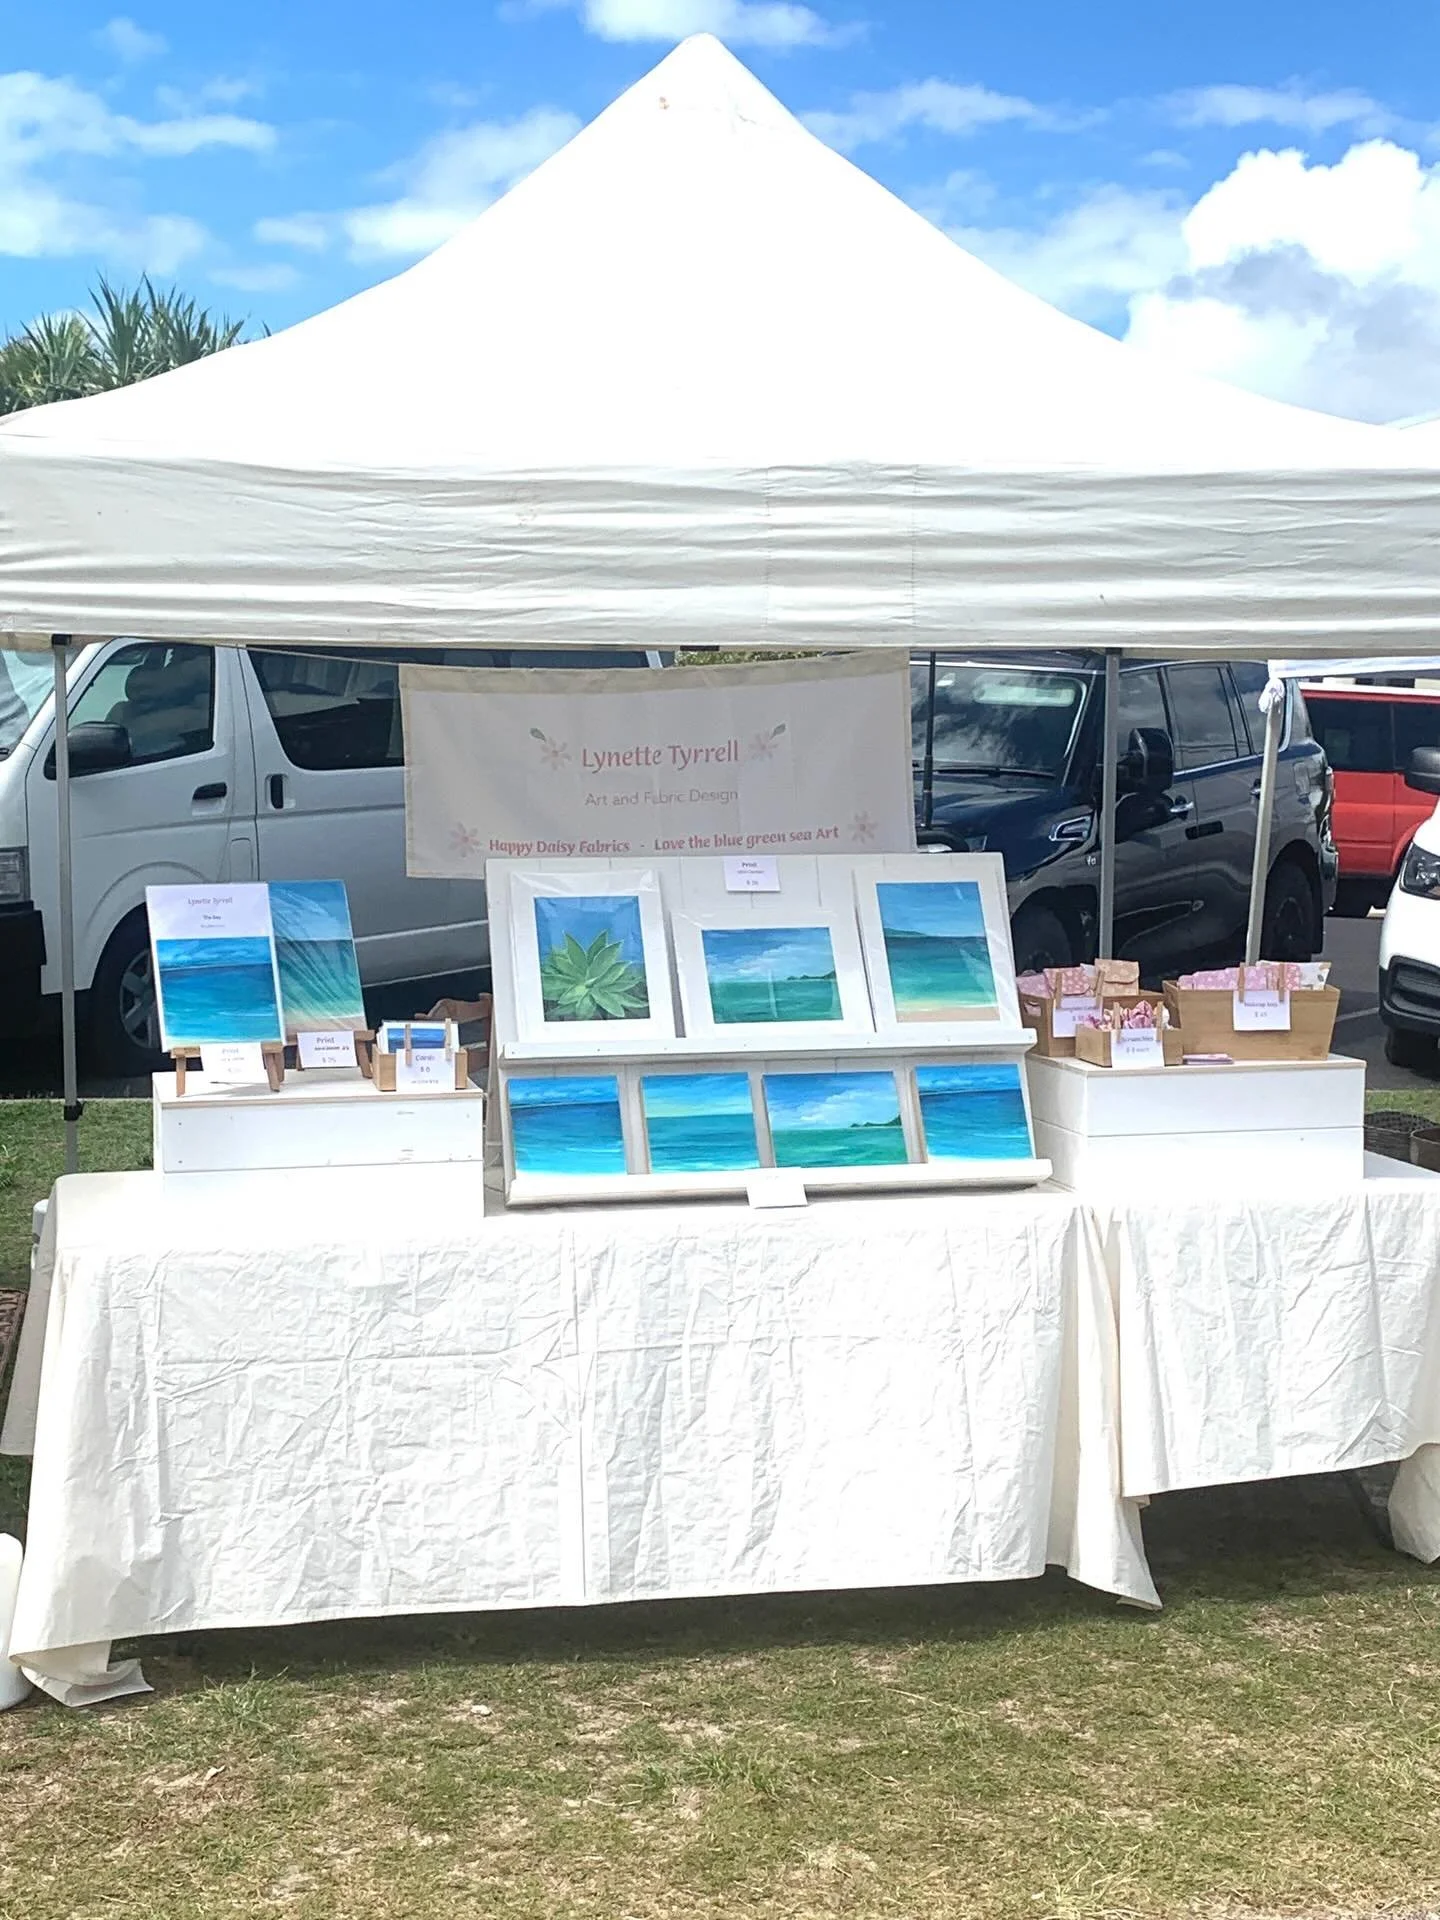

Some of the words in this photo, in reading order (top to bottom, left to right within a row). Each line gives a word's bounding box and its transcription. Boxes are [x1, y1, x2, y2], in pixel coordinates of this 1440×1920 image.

[582, 746, 662, 774] Lynette
[667, 739, 739, 771] Tyrrell
[584, 792, 608, 806] Art
[612, 791, 639, 806] and
[689, 787, 738, 805] Design
[489, 839, 533, 857] Happy
[536, 839, 576, 856] Daisy
[579, 840, 630, 853] Fabrics
[654, 838, 686, 851] Love
[688, 834, 711, 849] the
[714, 833, 744, 848] blue
[746, 832, 786, 849] green
[789, 830, 812, 842] sea
[815, 825, 840, 840] Art
